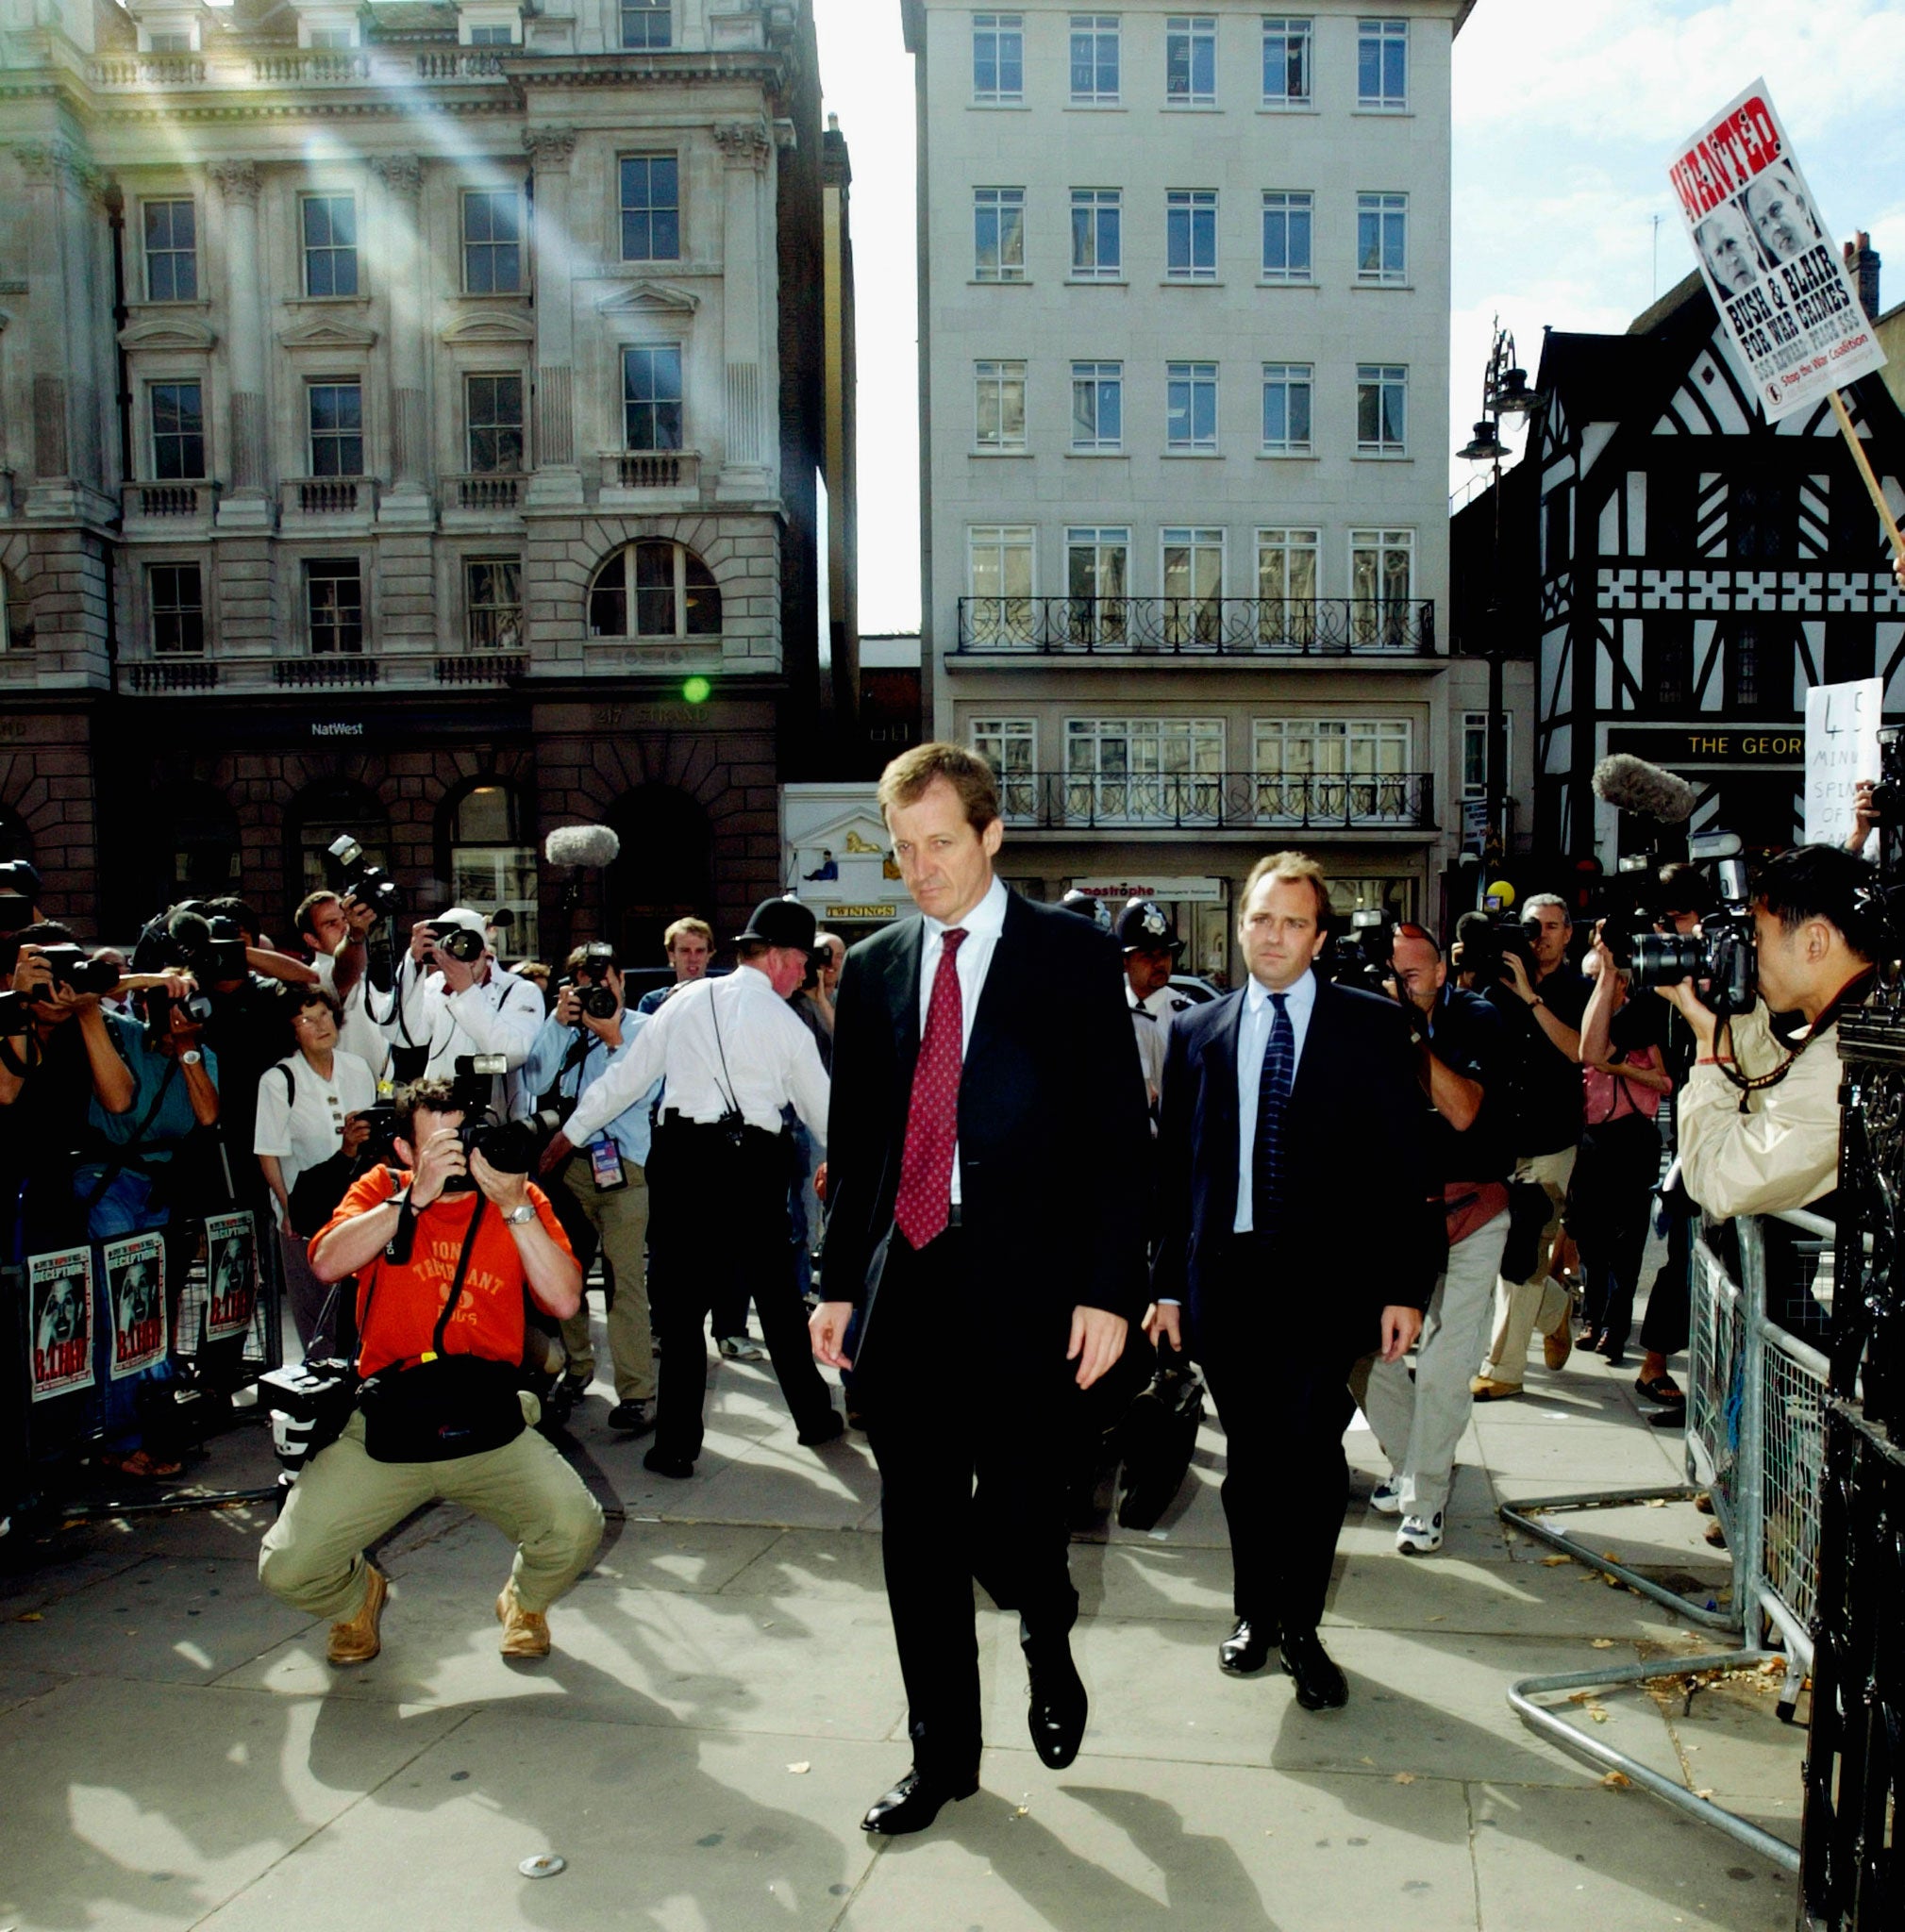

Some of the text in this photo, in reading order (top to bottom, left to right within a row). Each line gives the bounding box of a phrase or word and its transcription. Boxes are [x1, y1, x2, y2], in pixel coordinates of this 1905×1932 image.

[1669, 96, 1781, 223] WANTED
[1726, 244, 1839, 336] BUSH & BLAIR
[1739, 277, 1851, 362] FOR WAR CRIMES
[1829, 333, 1869, 360] Coalition
[311, 723, 364, 736] NatWest
[1688, 737, 1805, 755] THE GEOR
[827, 906, 895, 918] TWININGS
